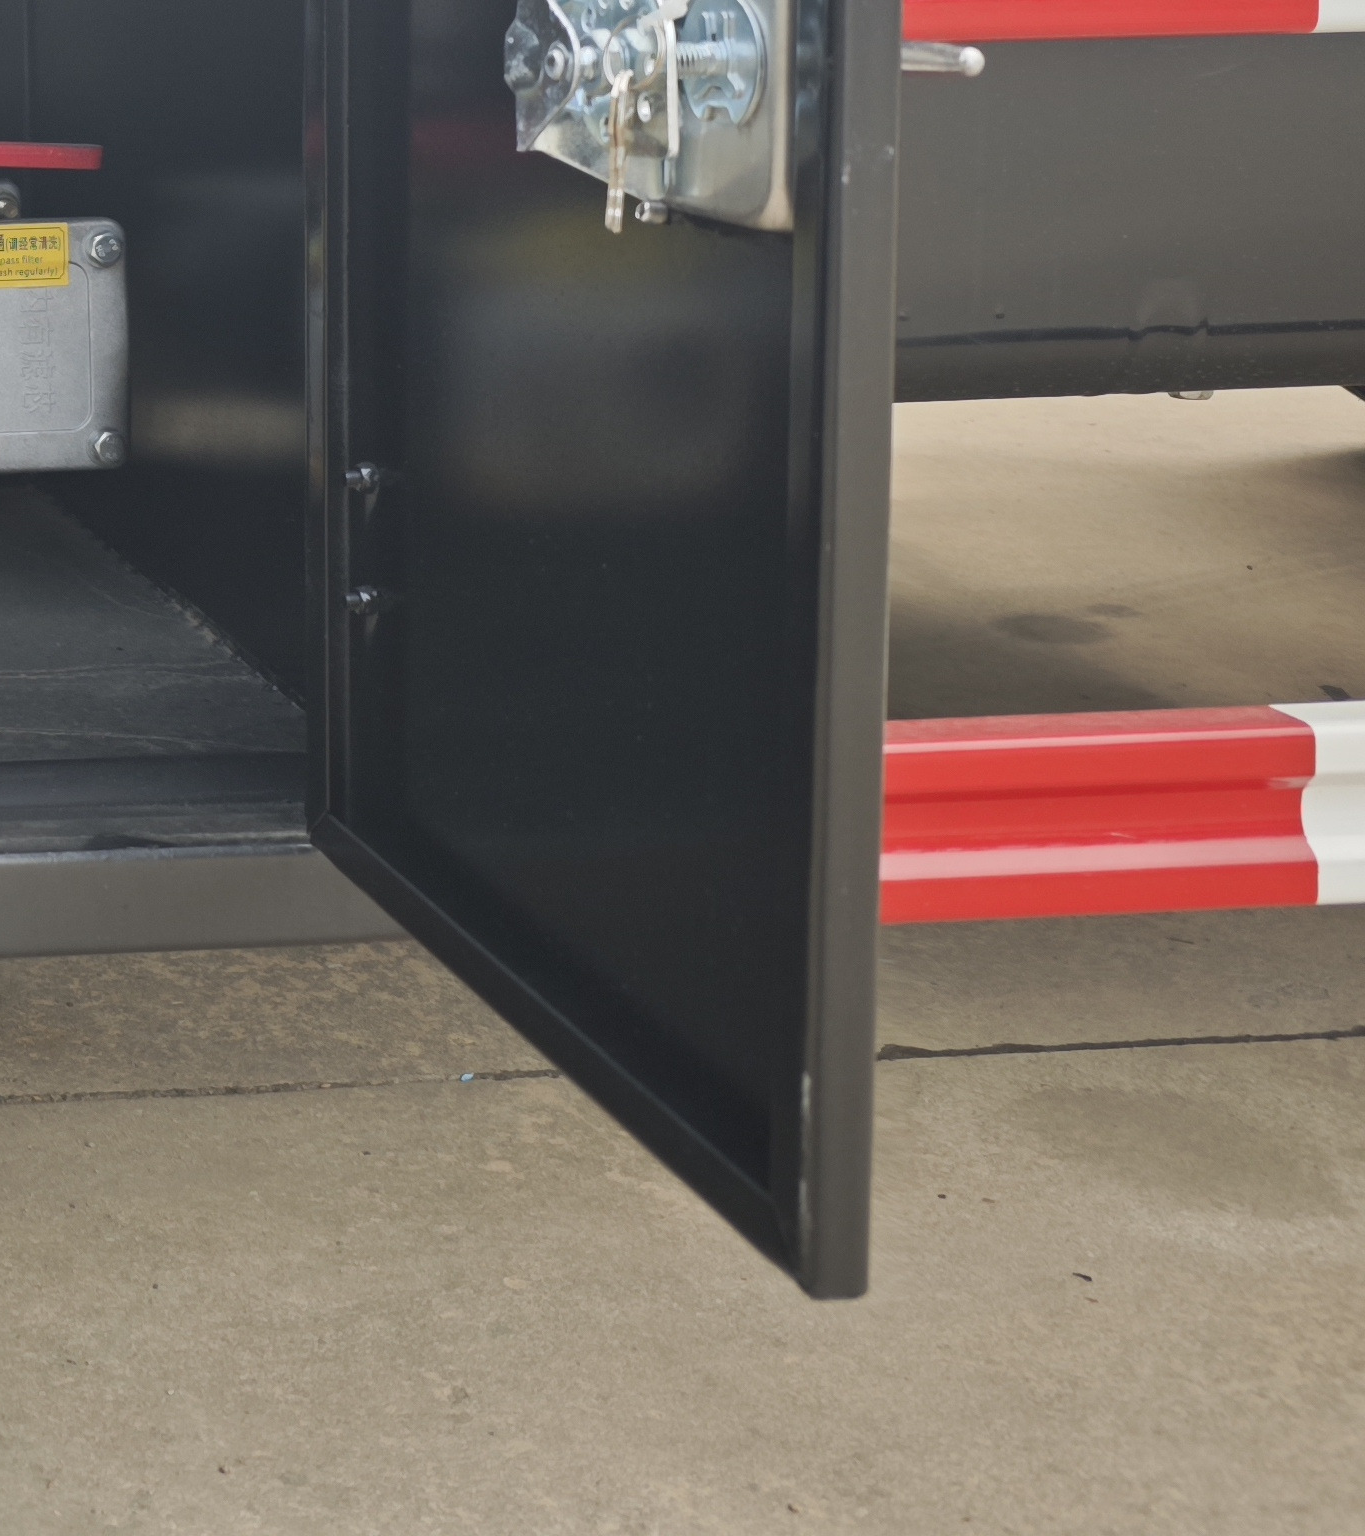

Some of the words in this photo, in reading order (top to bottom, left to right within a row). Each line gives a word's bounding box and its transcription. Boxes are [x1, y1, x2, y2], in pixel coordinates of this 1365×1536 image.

[0, 257, 20, 267] pass
[21, 255, 43, 264] filter
[14, 267, 58, 279] regularly)
